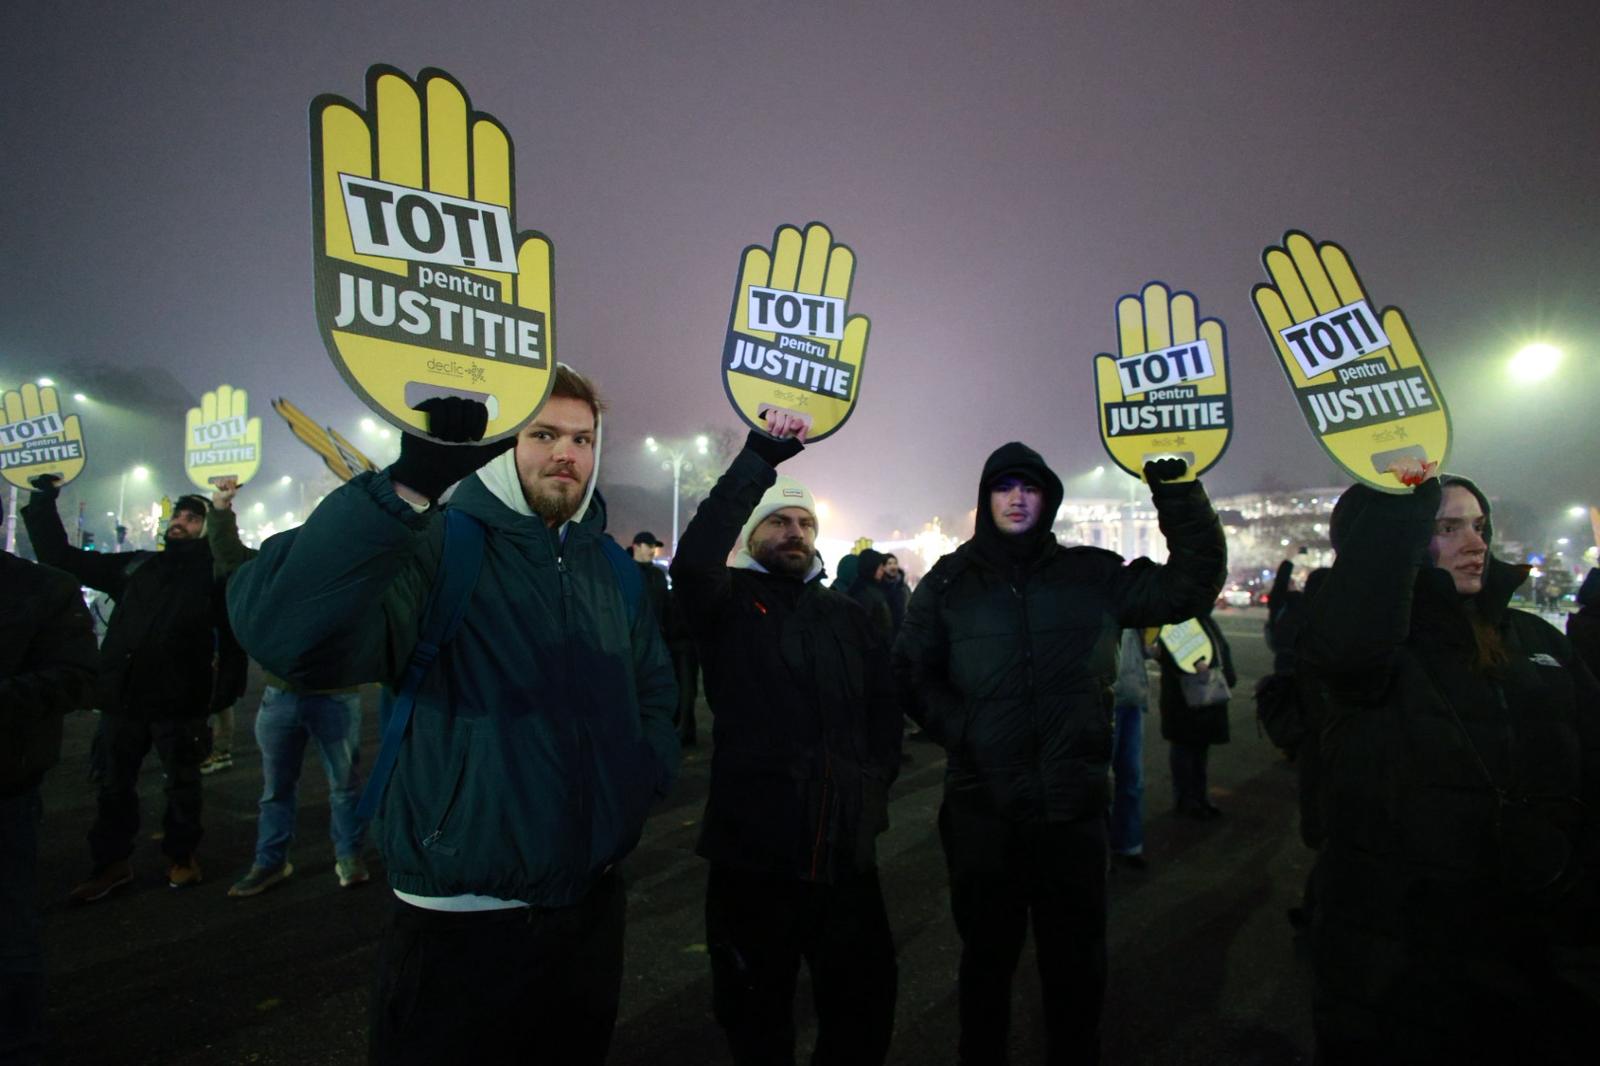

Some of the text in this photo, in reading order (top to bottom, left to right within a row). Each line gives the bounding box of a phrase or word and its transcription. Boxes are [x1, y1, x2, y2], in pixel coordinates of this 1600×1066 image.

[347, 182, 503, 266] TOȚI
[418, 266, 495, 302] pentru
[334, 272, 540, 360] JUSTIȚIE
[752, 290, 835, 335] TOȚI
[779, 335, 826, 358] pentru
[1285, 308, 1379, 368] TOȚI
[427, 357, 464, 375] declic
[730, 339, 850, 396] JUSTIȚIE
[1119, 345, 1204, 389] TOȚI
[1338, 361, 1387, 384] pentru
[1149, 388, 1194, 403] pentru
[1307, 376, 1433, 433] JUSTIȚIE
[1110, 401, 1225, 436] JUSTIȚIE
[26, 438, 57, 448] pentru
